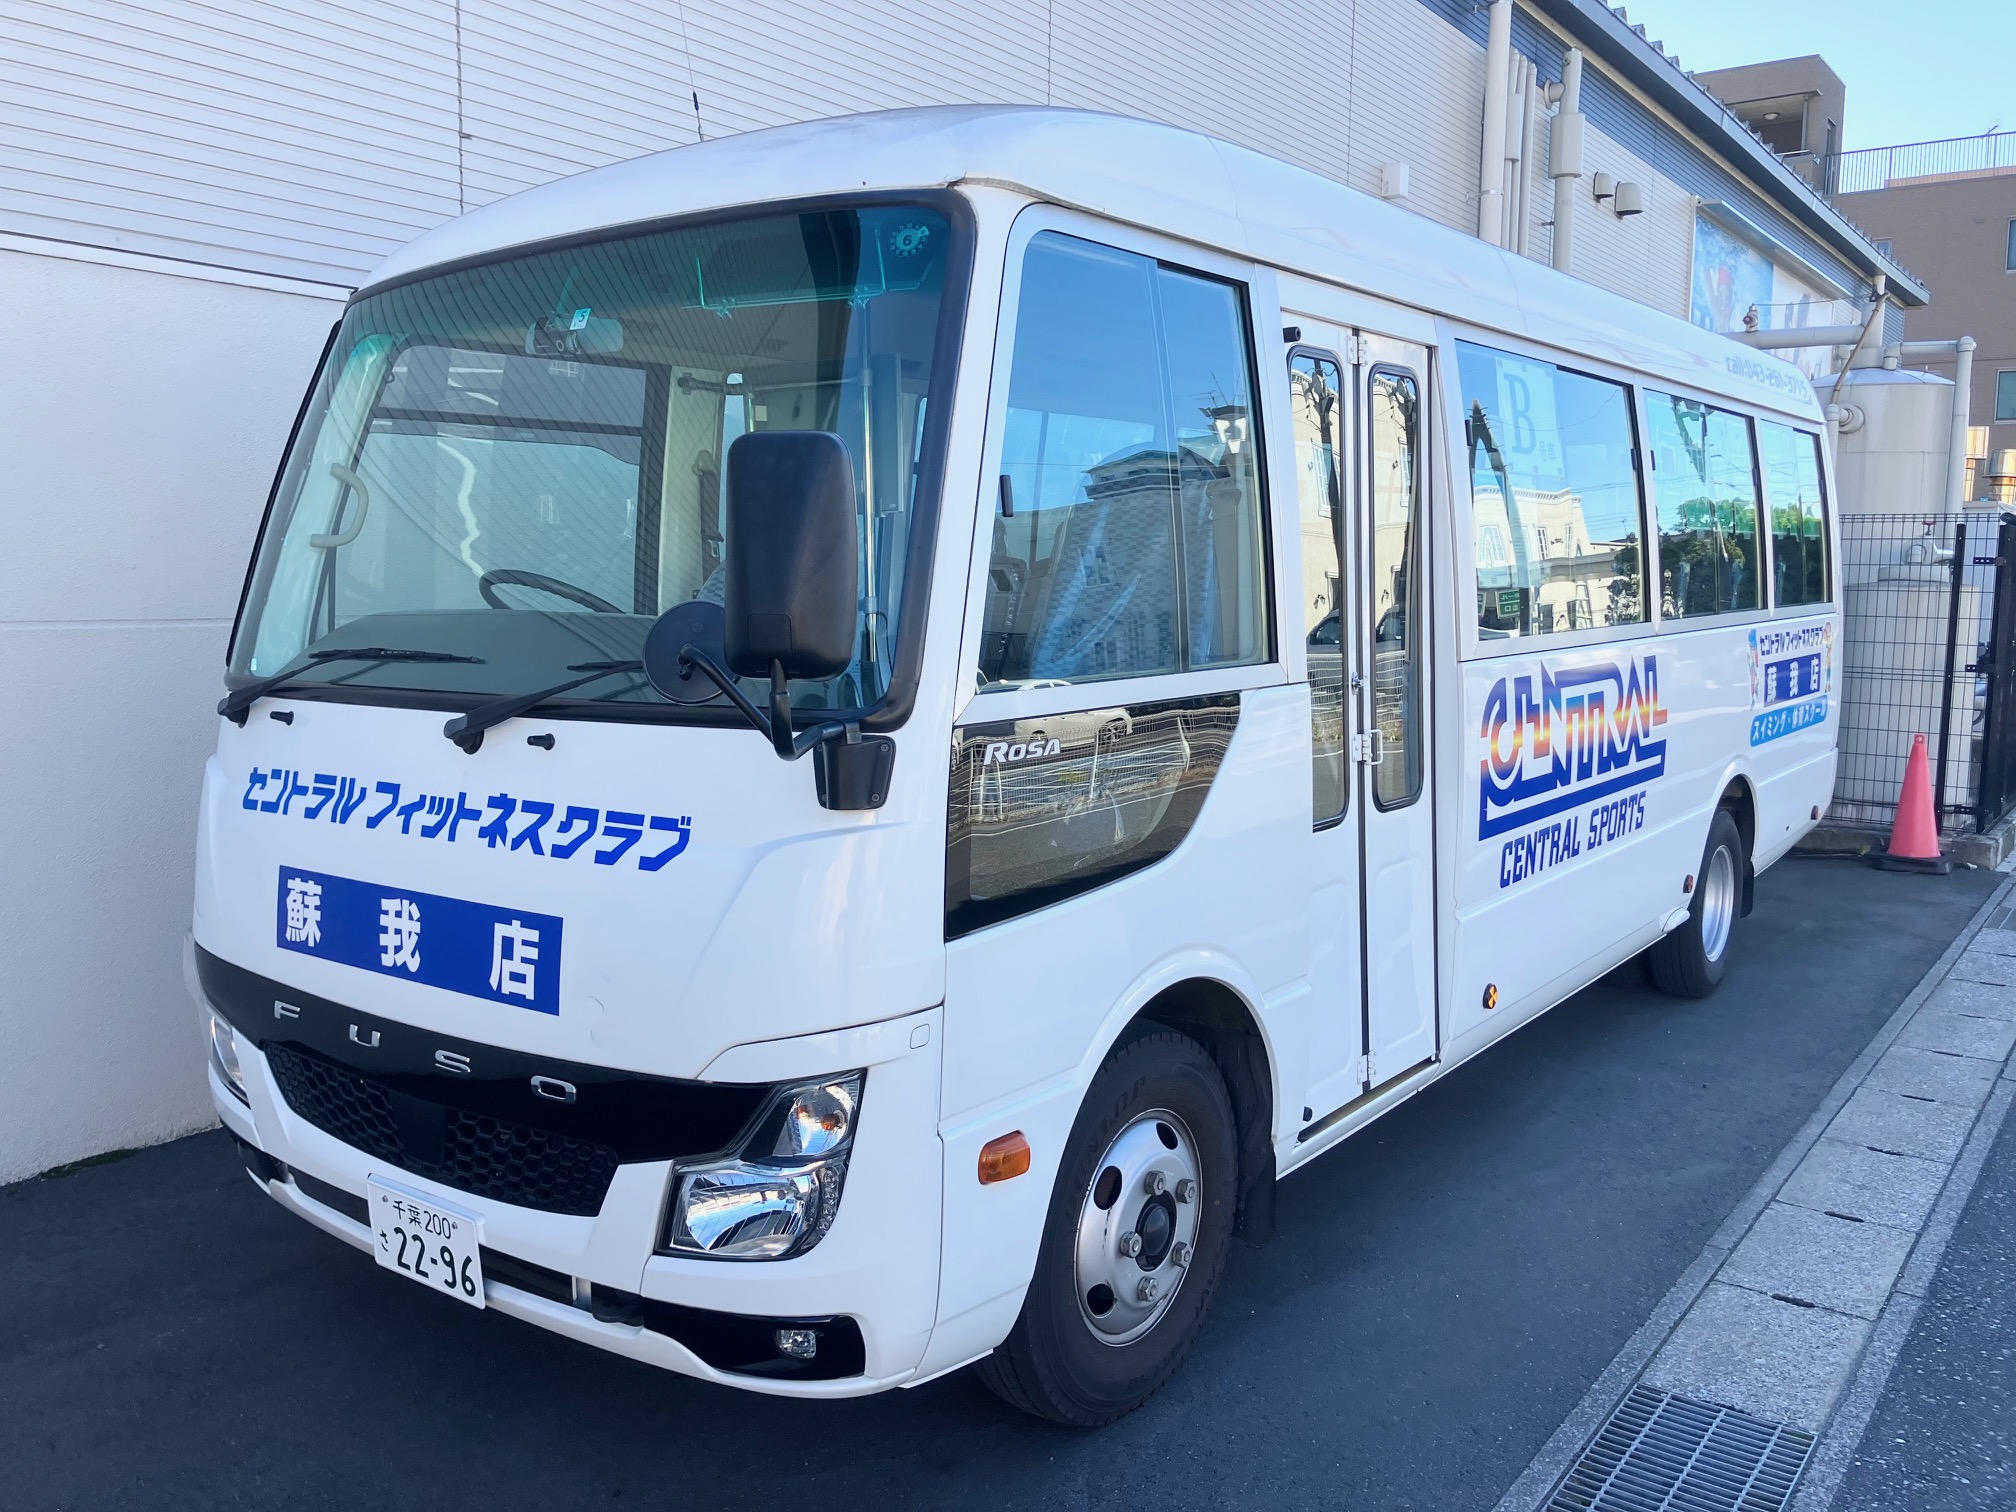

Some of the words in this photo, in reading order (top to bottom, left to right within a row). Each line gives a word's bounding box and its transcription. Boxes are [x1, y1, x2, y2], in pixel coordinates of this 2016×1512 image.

[902, 234, 913, 247] 6
[242, 766, 692, 872] セントラルフィットネスクラブ
[1500, 815, 1580, 889] CENTRAL
[1586, 790, 1647, 851] SPORTS
[285, 877, 540, 1001] 蘇我店
[273, 1000, 577, 1105] FUSO
[393, 1226, 476, 1297] 22-96
